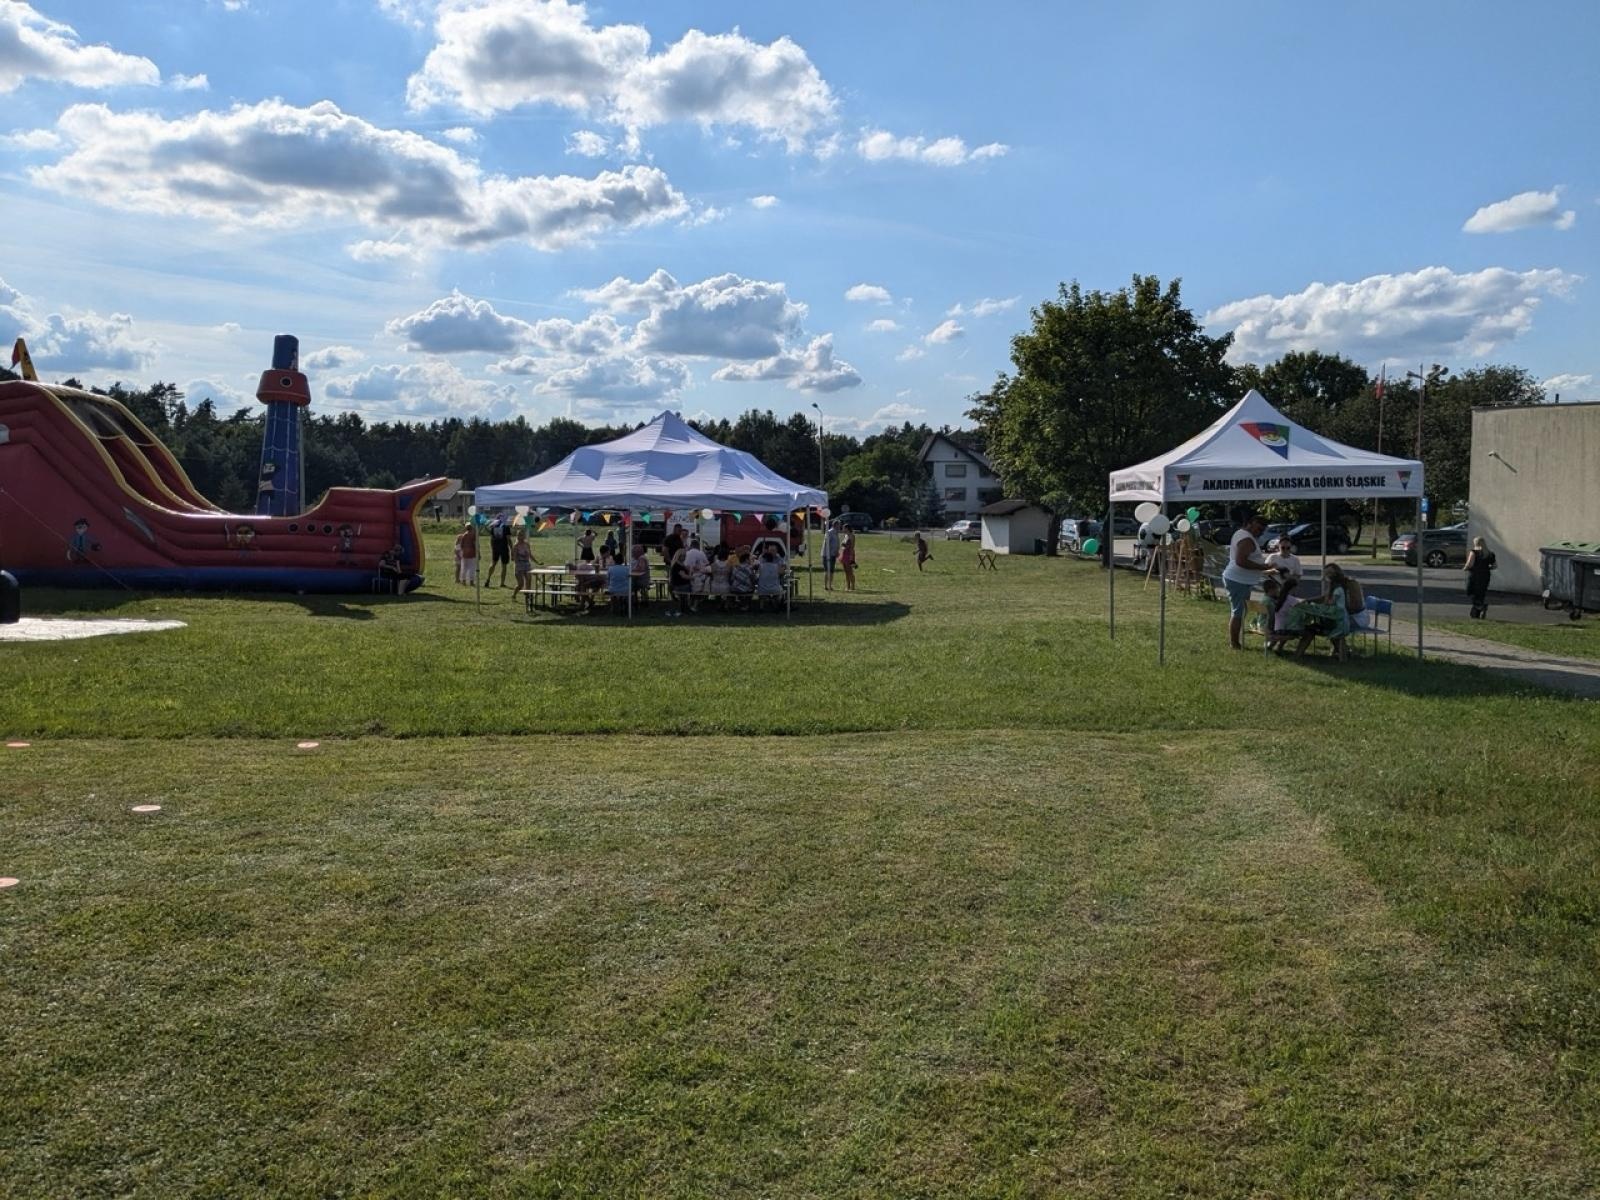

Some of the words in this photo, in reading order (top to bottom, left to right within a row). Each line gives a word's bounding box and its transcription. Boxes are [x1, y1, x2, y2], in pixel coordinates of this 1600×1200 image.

[1203, 479, 1254, 490] AKADEMIA
[1255, 477, 1311, 489] PIŁKARSKA
[1313, 474, 1345, 488] GÓRKI
[1346, 474, 1386, 489] ŚLĄSKIE
